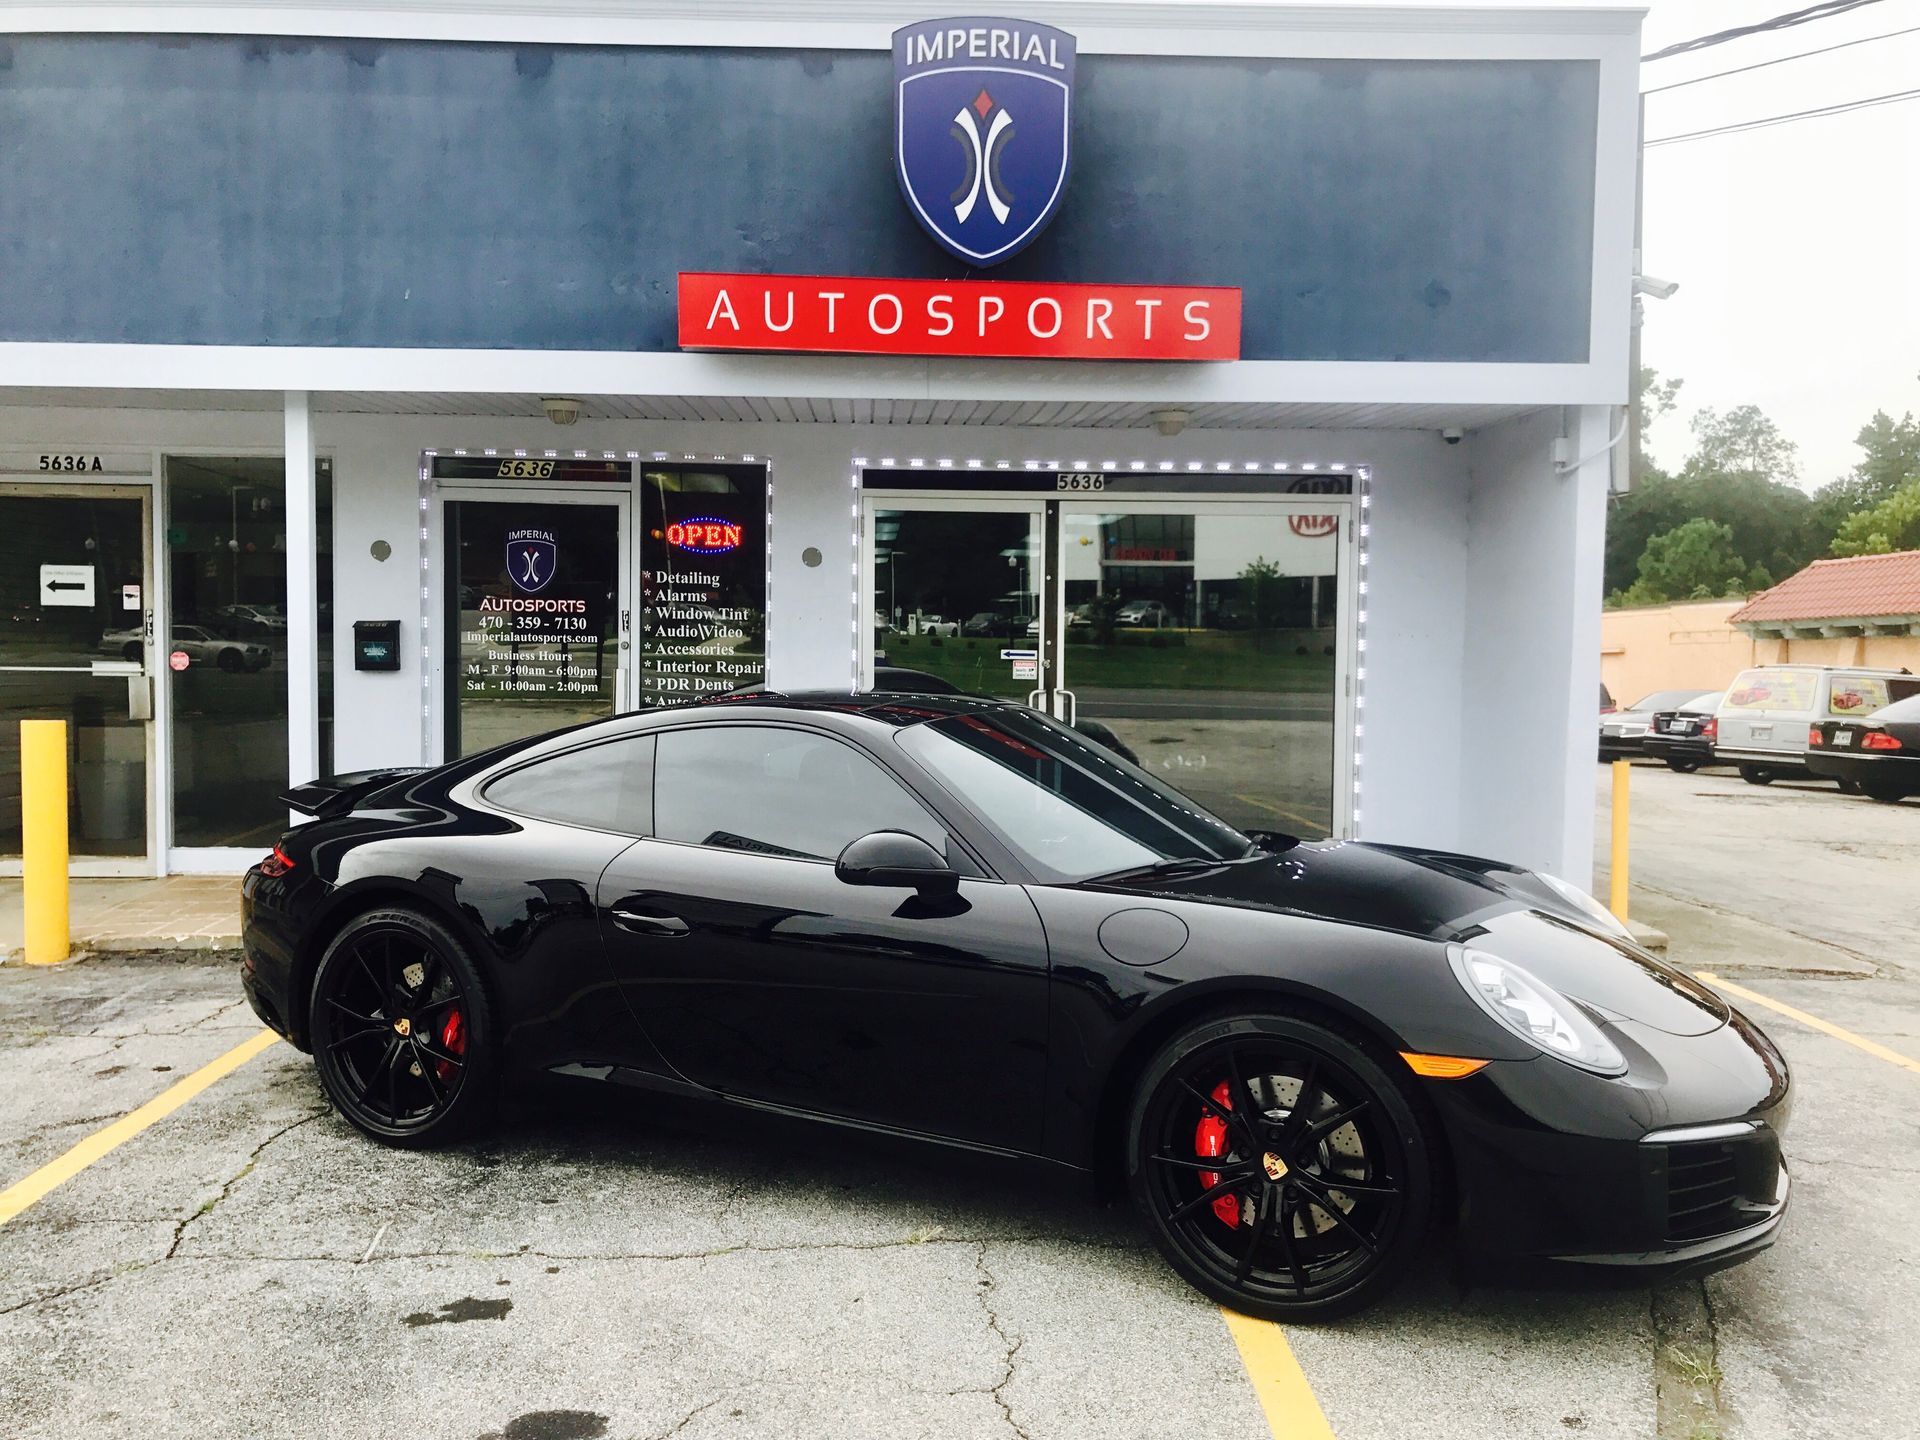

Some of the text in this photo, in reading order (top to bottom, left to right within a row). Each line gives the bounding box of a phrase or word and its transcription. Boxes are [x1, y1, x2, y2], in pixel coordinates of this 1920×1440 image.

[906, 28, 1065, 70] IMPERIAL
[705, 289, 1211, 342] AUTOSPORTS
[500, 460, 553, 477] 5636
[1058, 474, 1103, 490] 5636
[508, 529, 555, 542] IMPERIAL
[667, 524, 741, 546] OPEN
[656, 570, 721, 588] Detailing
[655, 589, 708, 603] Alarms
[479, 598, 586, 613] AUTOSPORTS
[655, 606, 749, 621] Window Tint
[478, 616, 503, 629] 470
[516, 616, 541, 629] 359
[554, 617, 587, 630] 7130
[467, 631, 598, 645] imperialautosports.com
[488, 650, 573, 662] Business Hours
[655, 642, 735, 656] Accessories
[467, 664, 480, 675] M
[491, 664, 500, 675] F
[504, 664, 546, 676] 9:00am
[556, 665, 598, 678] 6:00pm
[656, 660, 764, 677] Interior Repair
[466, 680, 486, 691] Sat
[499, 681, 546, 692] 10:00am
[556, 681, 599, 694] 2:00pm
[656, 677, 735, 691] PDR Dents
